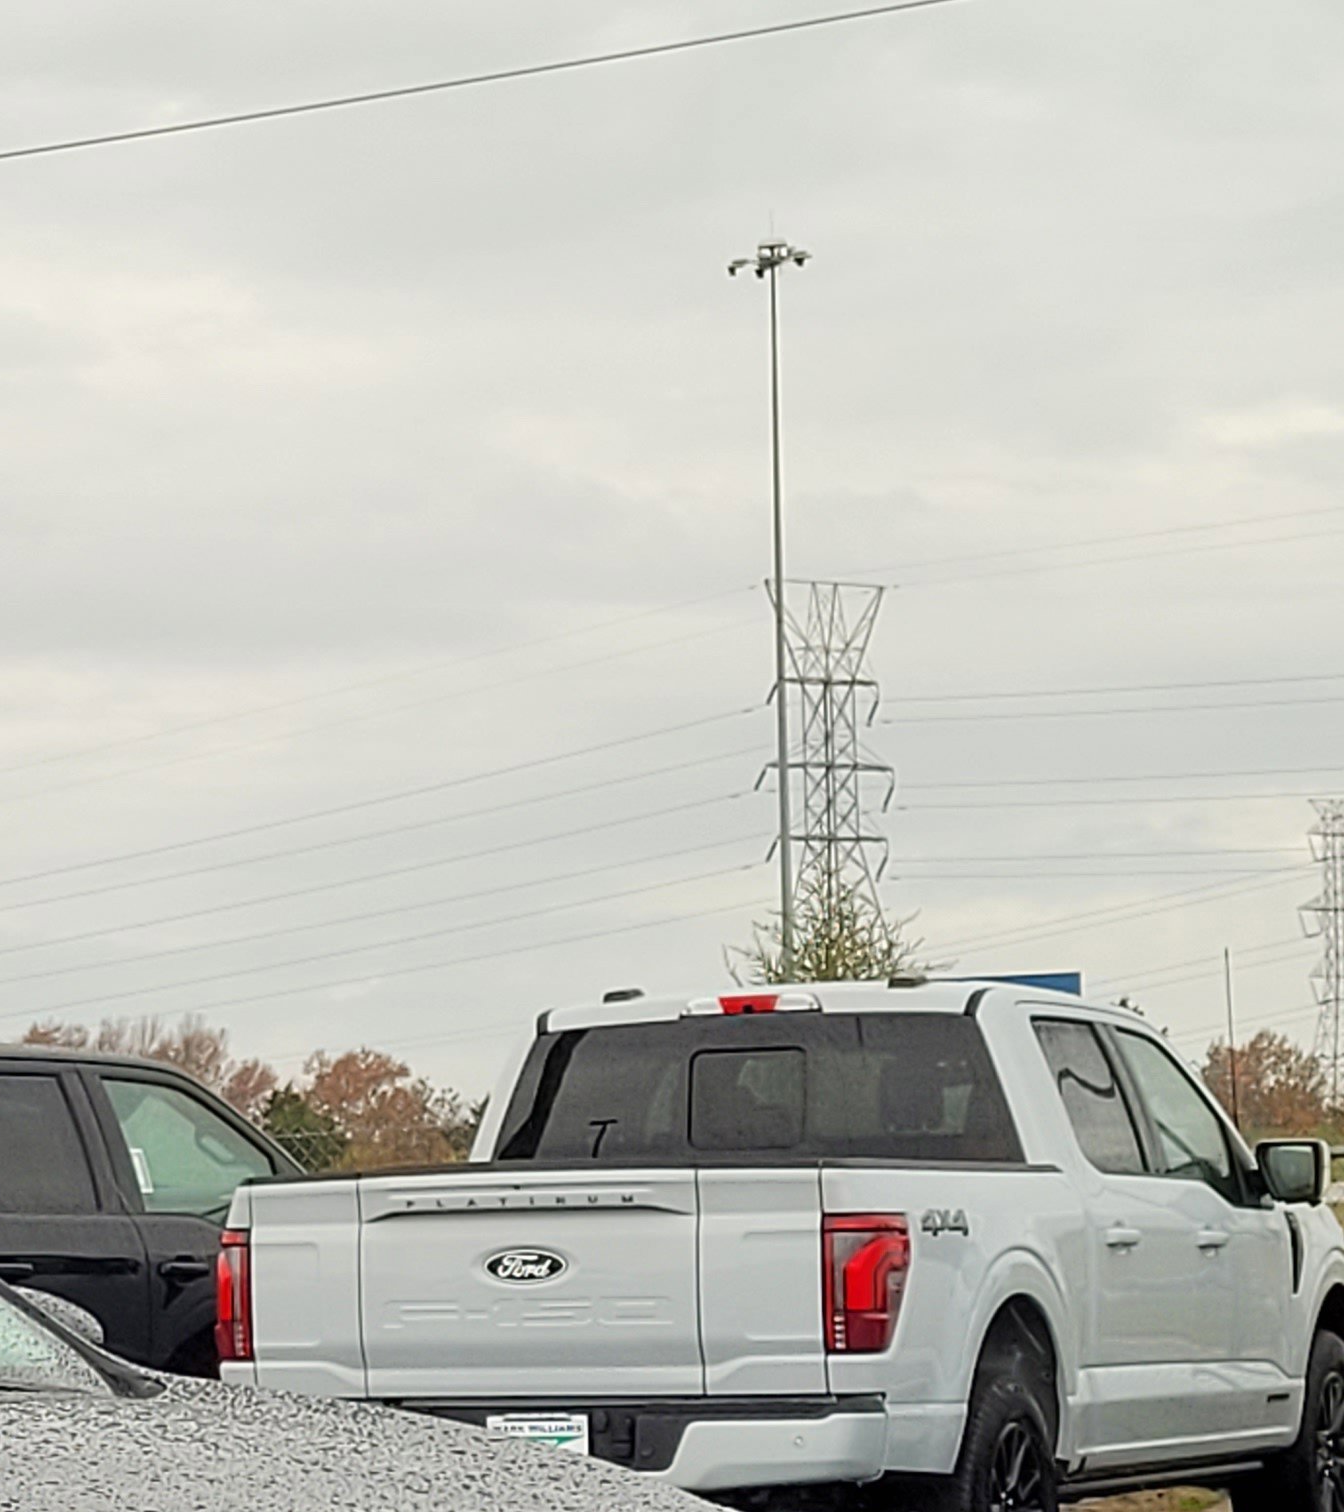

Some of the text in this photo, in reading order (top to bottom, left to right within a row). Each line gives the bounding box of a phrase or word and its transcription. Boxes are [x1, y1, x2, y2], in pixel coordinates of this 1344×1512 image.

[406, 1194, 635, 1209] PLATINUM
[496, 1254, 553, 1278] Ford
[381, 1295, 675, 1330] F-150
